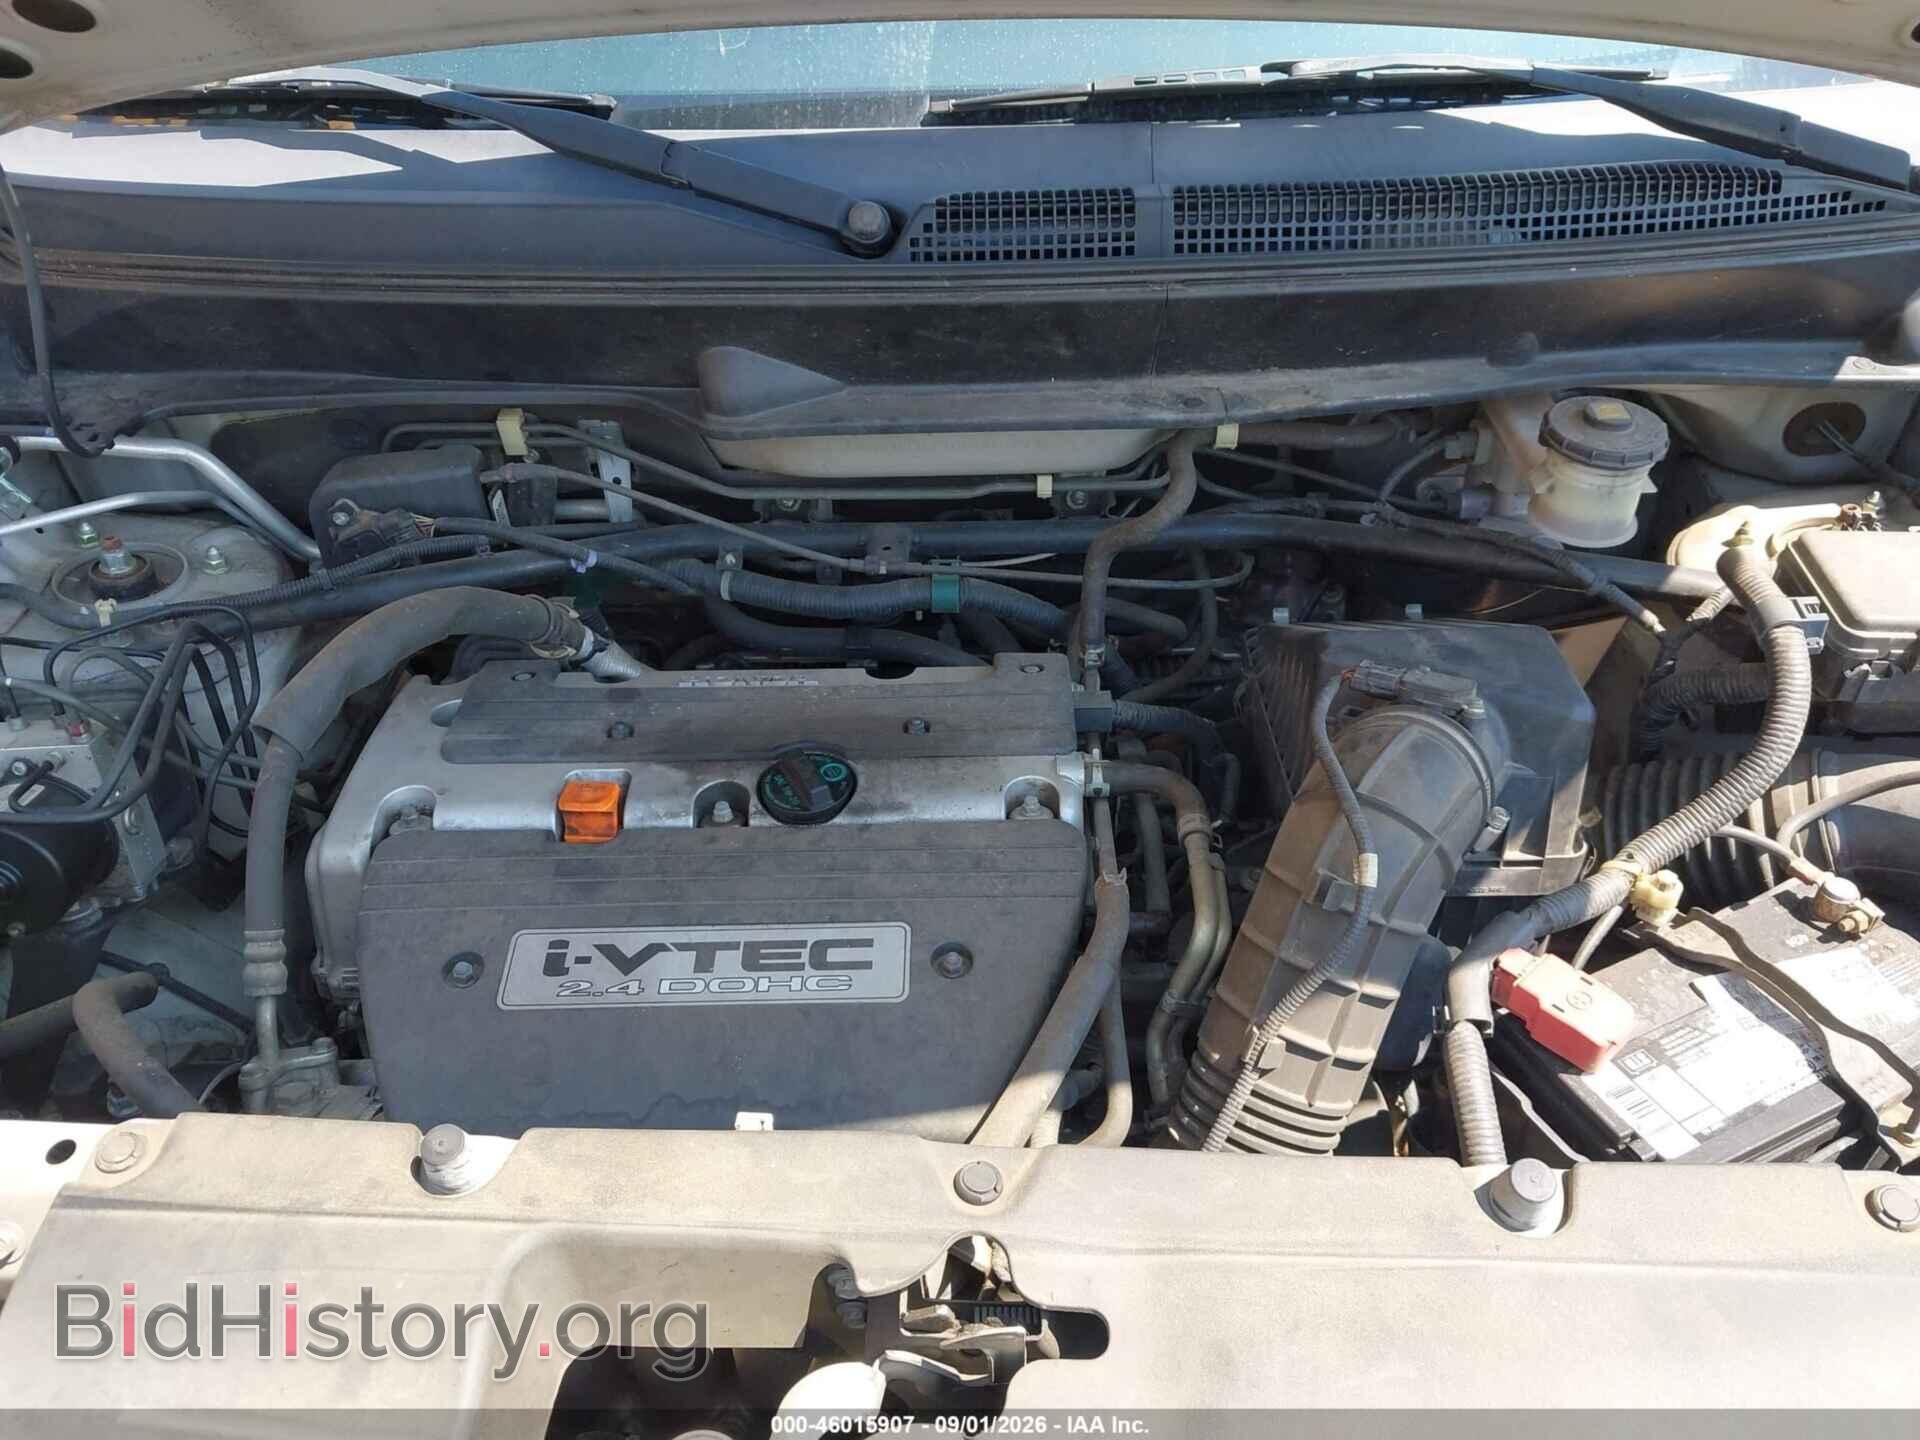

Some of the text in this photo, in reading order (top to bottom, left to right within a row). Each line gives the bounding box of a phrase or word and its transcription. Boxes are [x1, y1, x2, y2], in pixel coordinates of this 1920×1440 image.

[542, 938, 875, 977] i-VTEC
[556, 975, 853, 998] 2.4 DOHC
